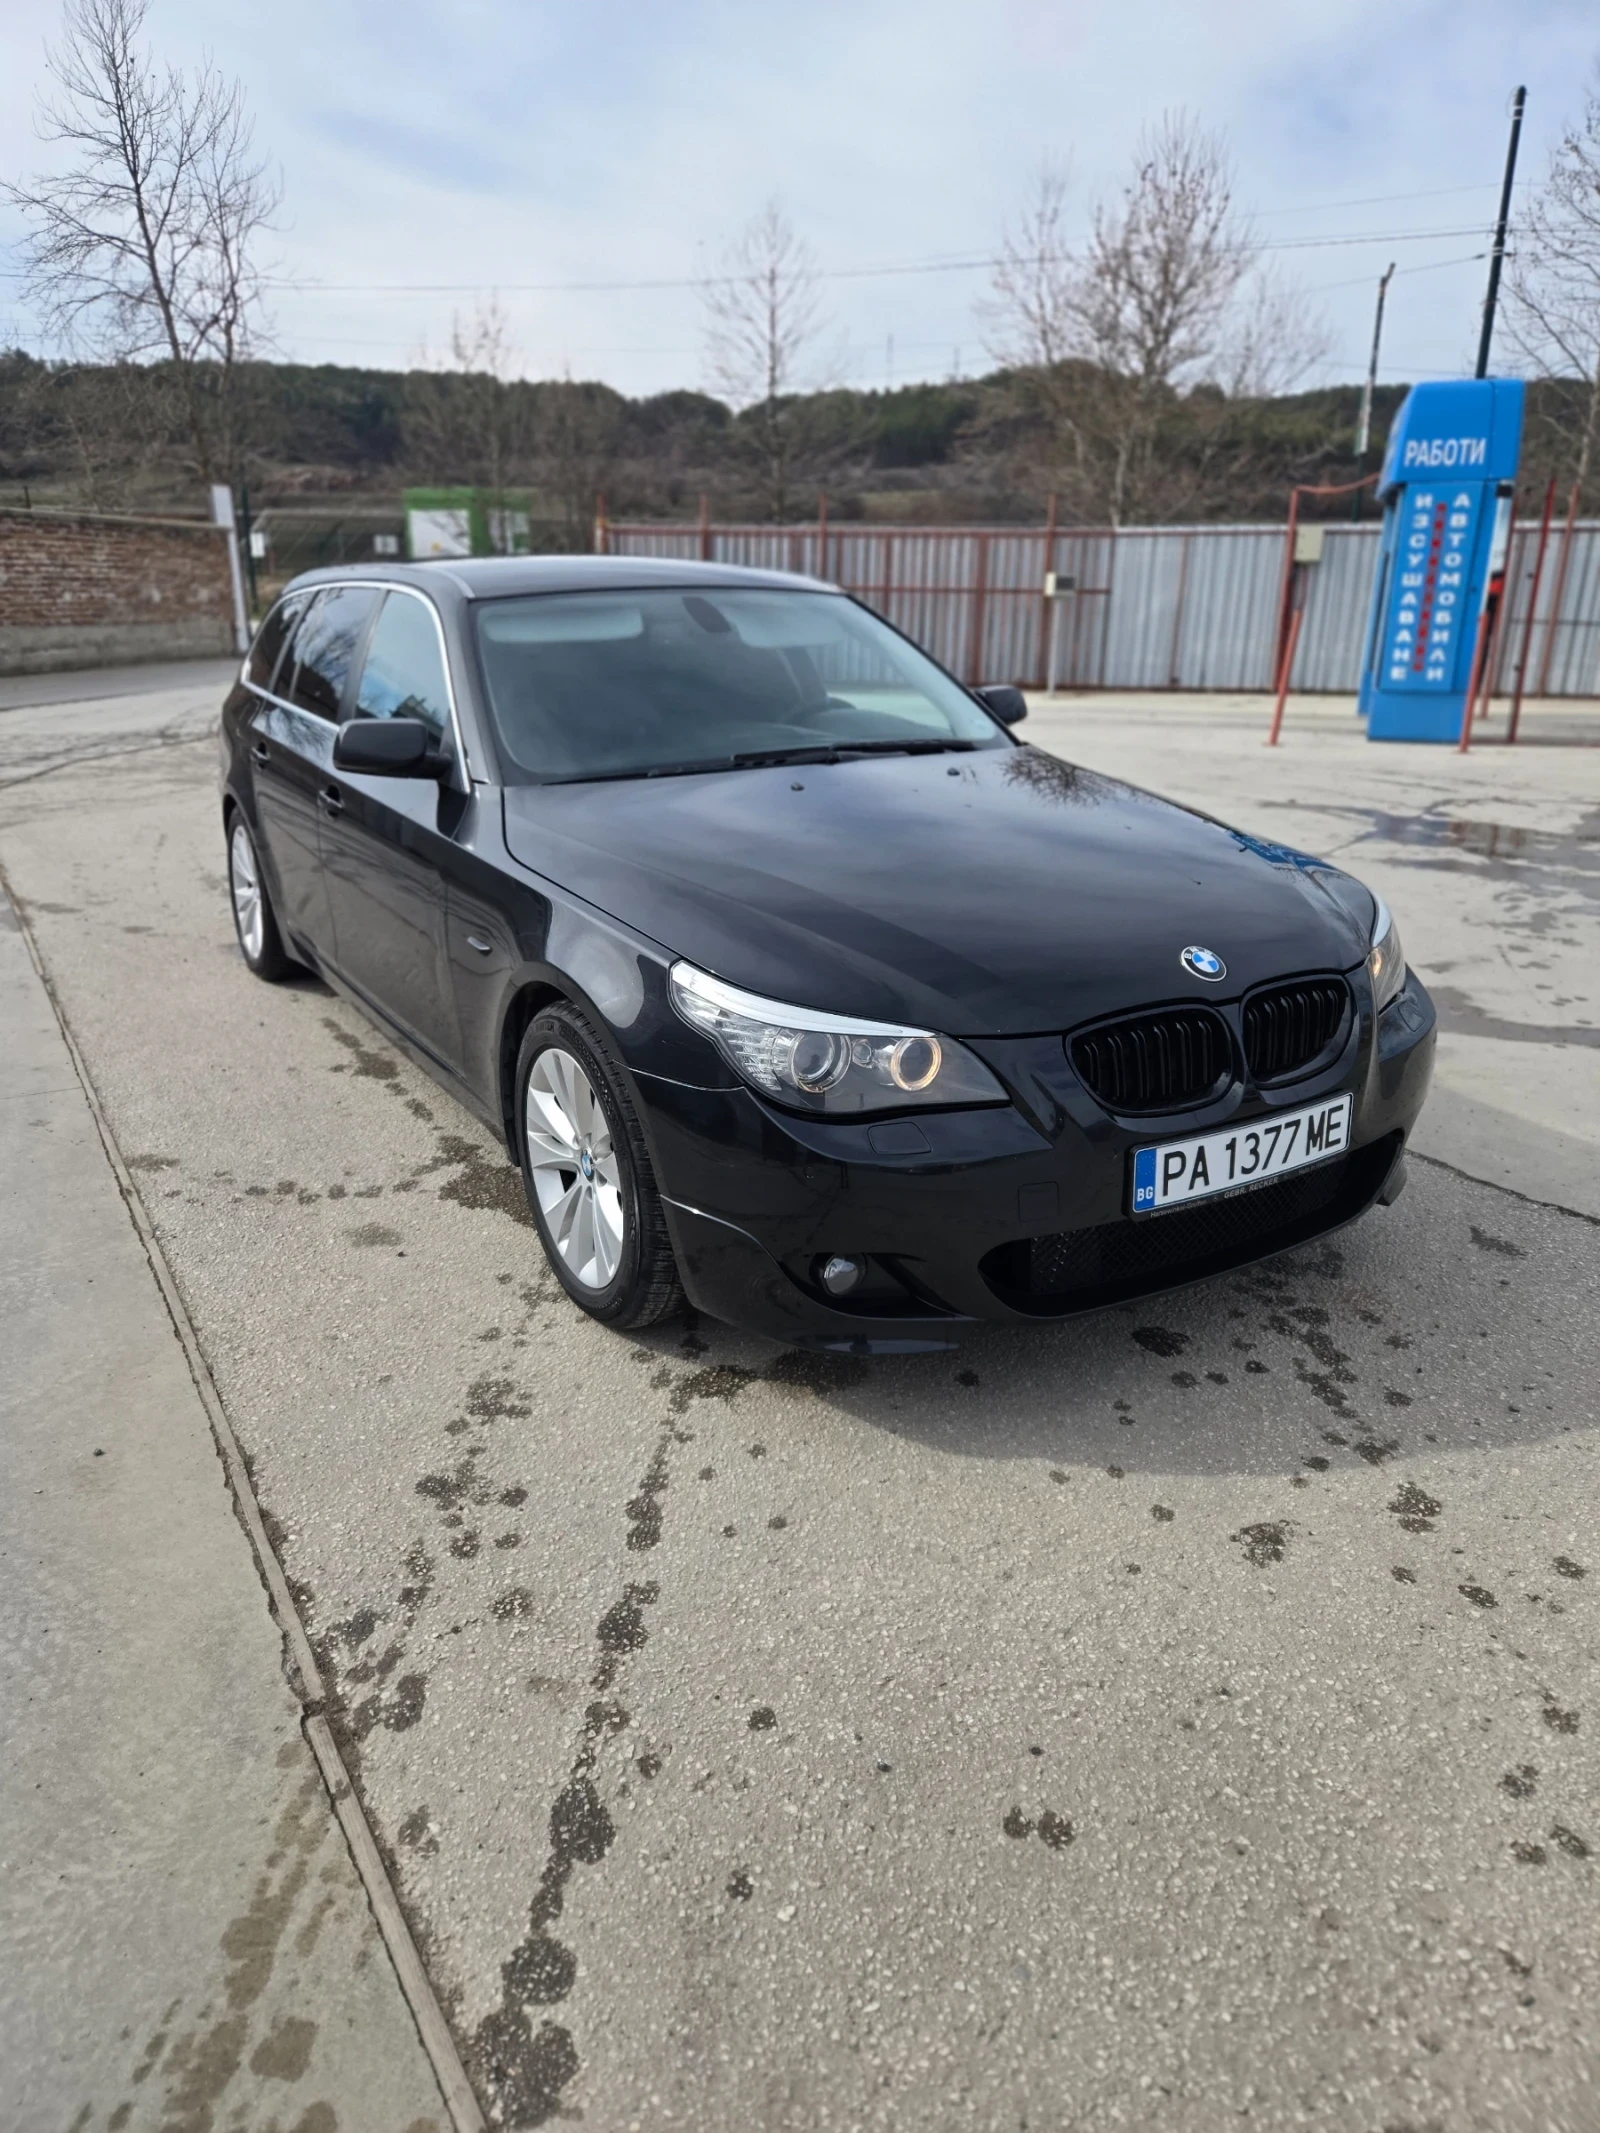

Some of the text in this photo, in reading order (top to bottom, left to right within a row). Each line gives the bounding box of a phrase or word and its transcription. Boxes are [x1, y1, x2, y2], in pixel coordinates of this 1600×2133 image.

[1404, 438, 1487, 467] РАБОТИ
[1391, 493, 1433, 681] ИЗСУШАВАНЕ
[1426, 492, 1471, 681] АВТОМОБИЛИ
[1162, 1104, 1344, 1196] PA 1377 ME
[1137, 1187, 1154, 1202] BG
[1224, 1187, 1247, 1199] GEBR.
[1249, 1177, 1279, 1192] RECKER
